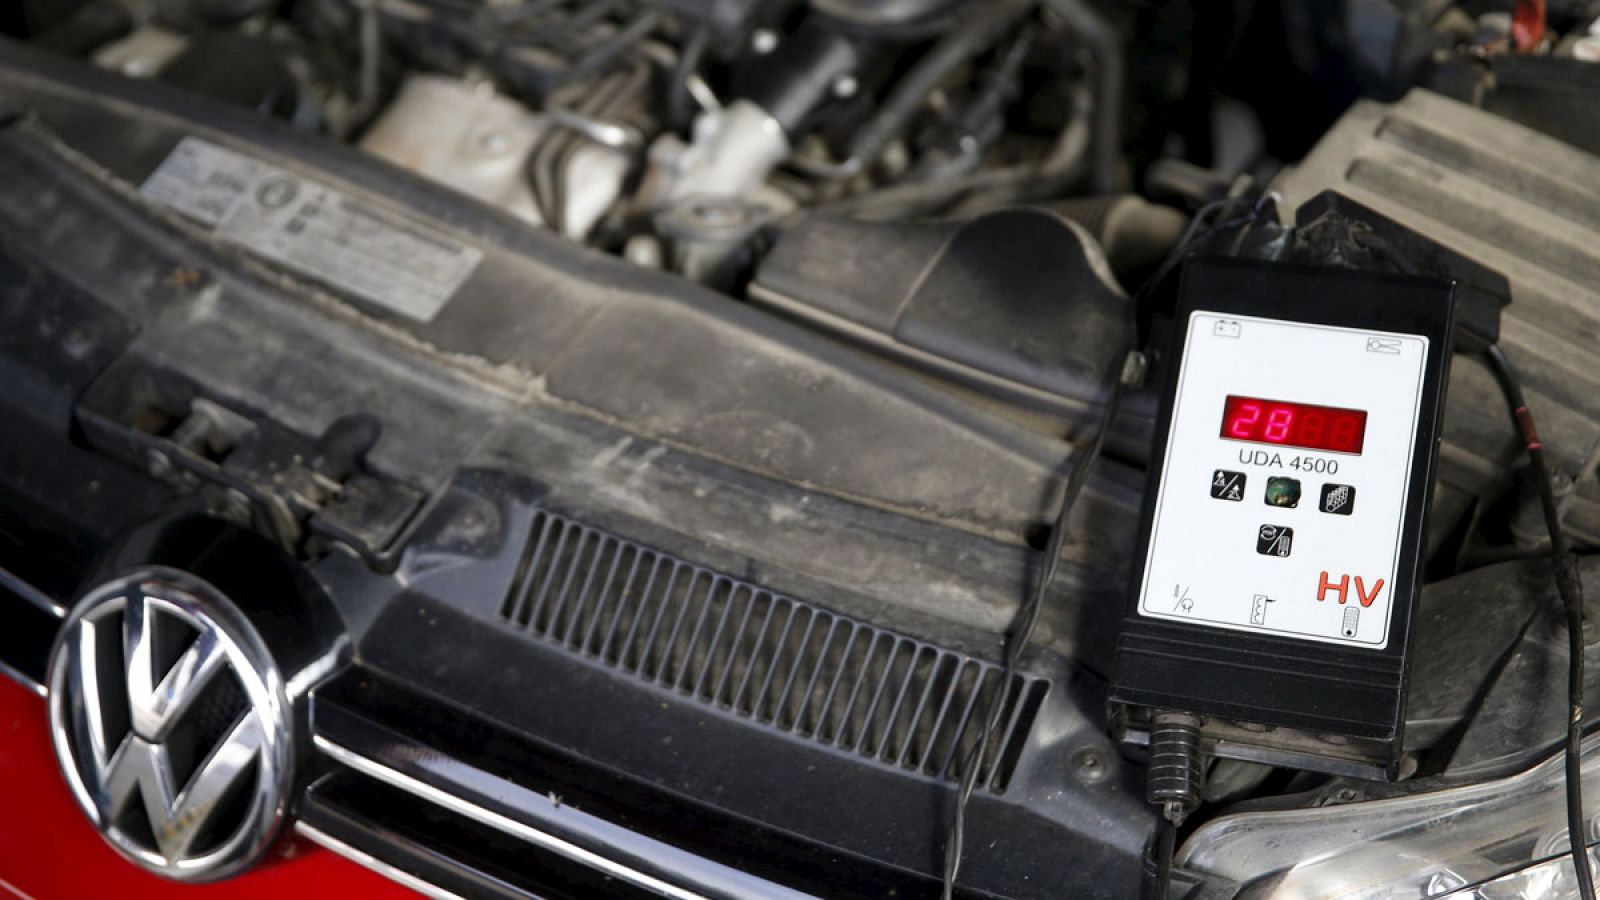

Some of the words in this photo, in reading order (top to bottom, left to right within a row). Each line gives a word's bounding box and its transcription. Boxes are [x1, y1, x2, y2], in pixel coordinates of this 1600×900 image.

[1239, 449, 1283, 469] UDA
[1290, 456, 1339, 475] 4500
[1317, 571, 1385, 608] HV
[52, 572, 286, 874] VW
